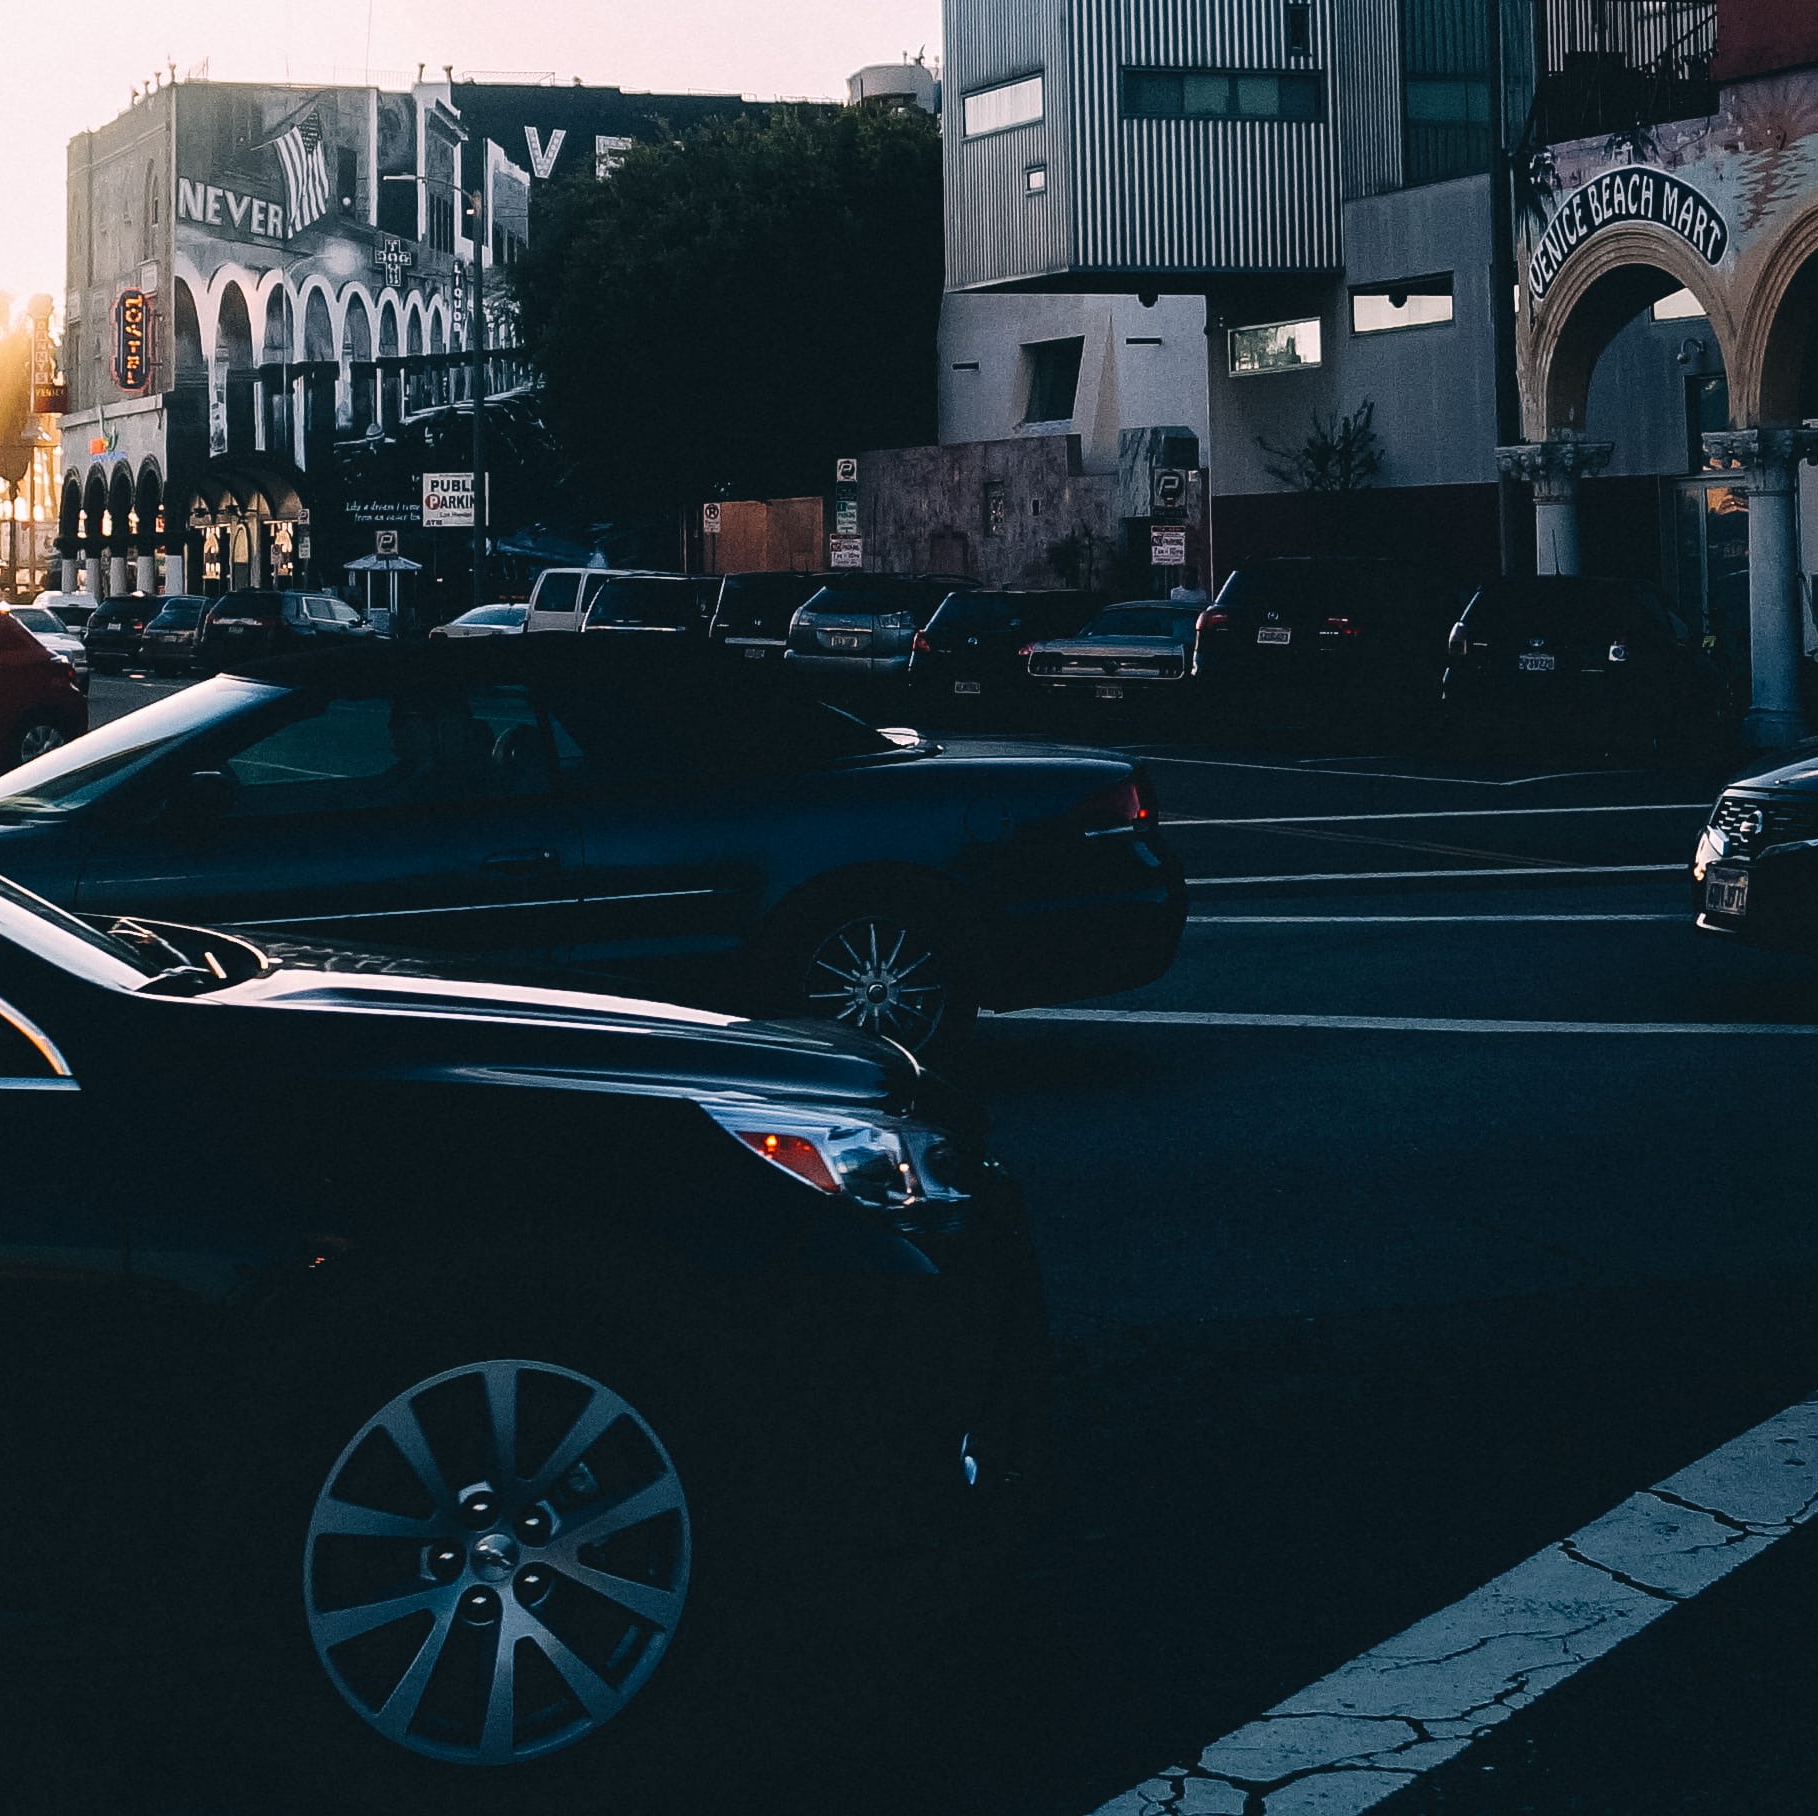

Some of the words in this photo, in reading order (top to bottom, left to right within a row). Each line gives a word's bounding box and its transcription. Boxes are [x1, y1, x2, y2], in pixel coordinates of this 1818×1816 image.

[178, 177, 283, 239] NEVER
[1587, 172, 1654, 226] BEACH
[1662, 180, 1722, 261] MART
[452, 261, 463, 333] LIQUOR
